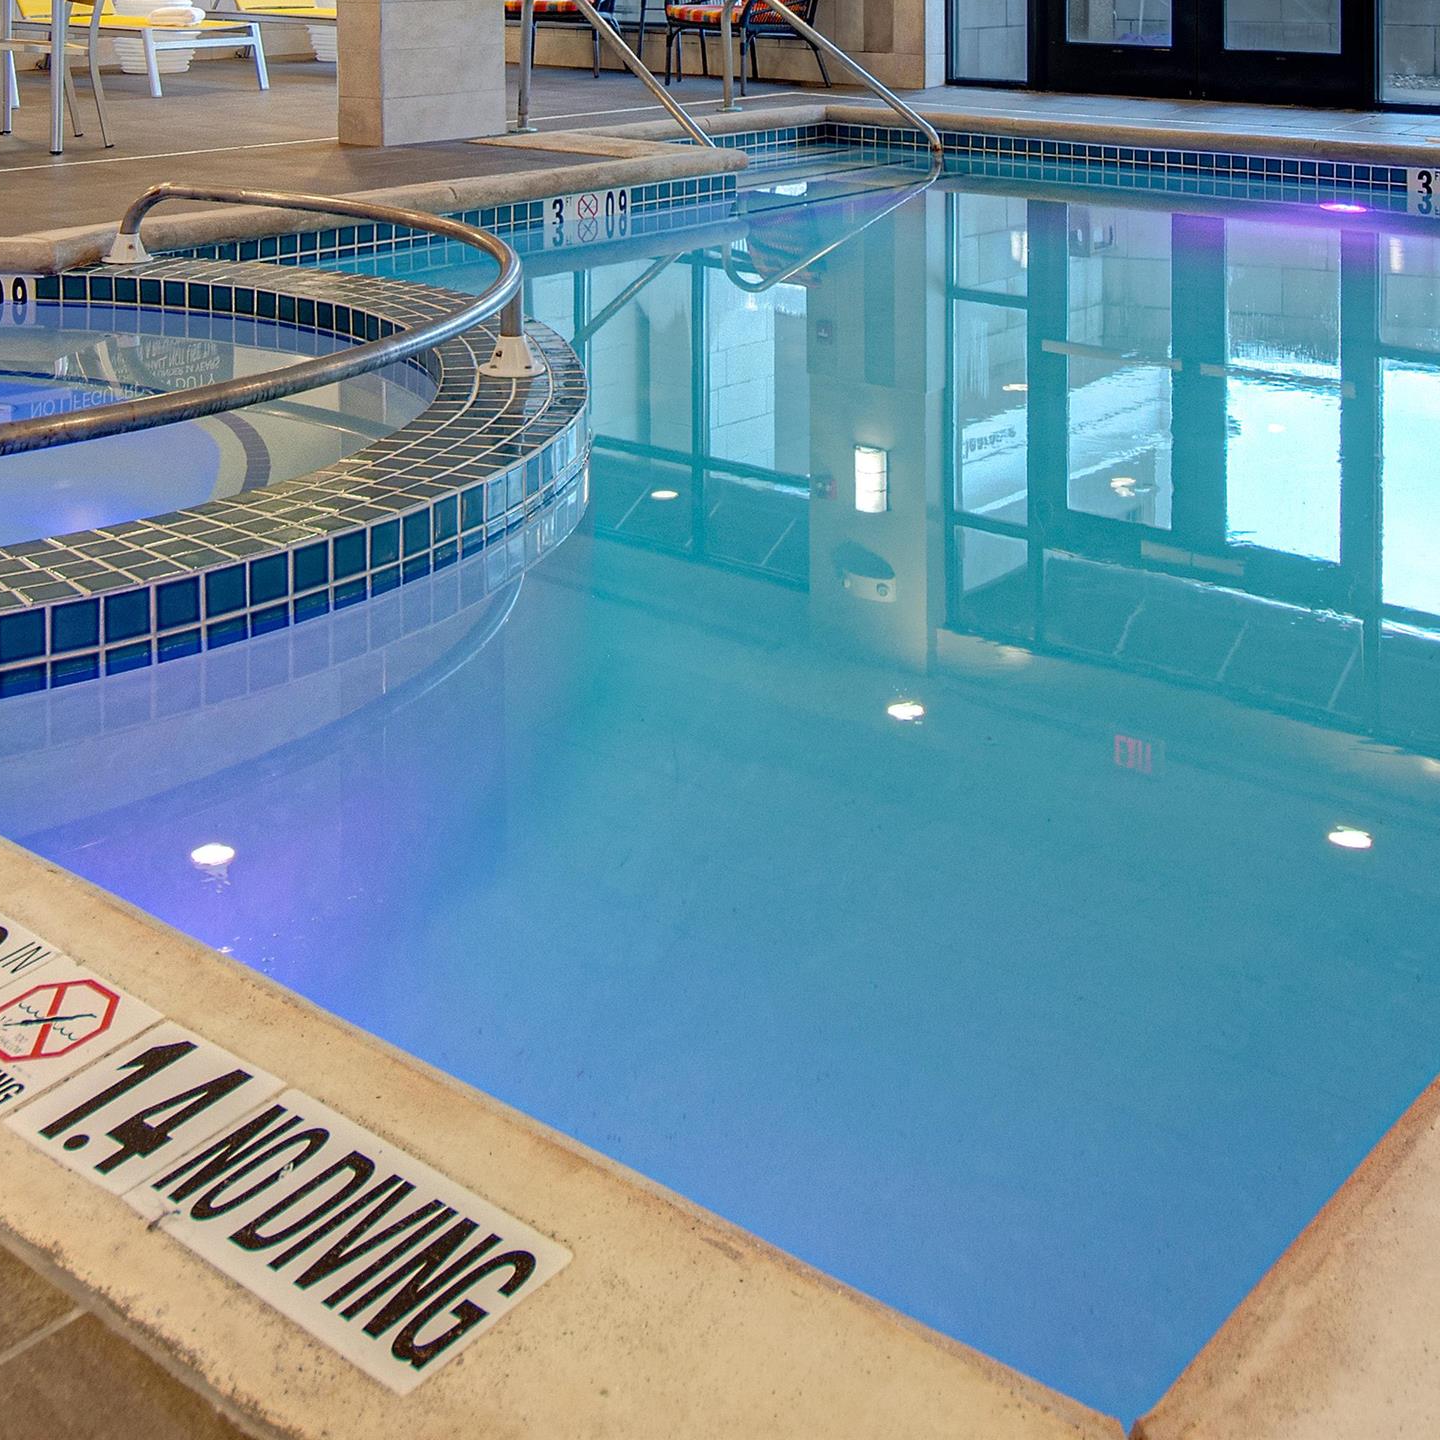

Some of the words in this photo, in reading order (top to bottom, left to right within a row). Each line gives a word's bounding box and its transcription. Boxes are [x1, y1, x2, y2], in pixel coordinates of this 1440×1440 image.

[552, 198, 564, 225] 3
[1418, 170, 1433, 195] 3
[39, 1040, 253, 1174] 1.4
[151, 1103, 330, 1222] NO
[228, 1148, 536, 1371] DIVING
